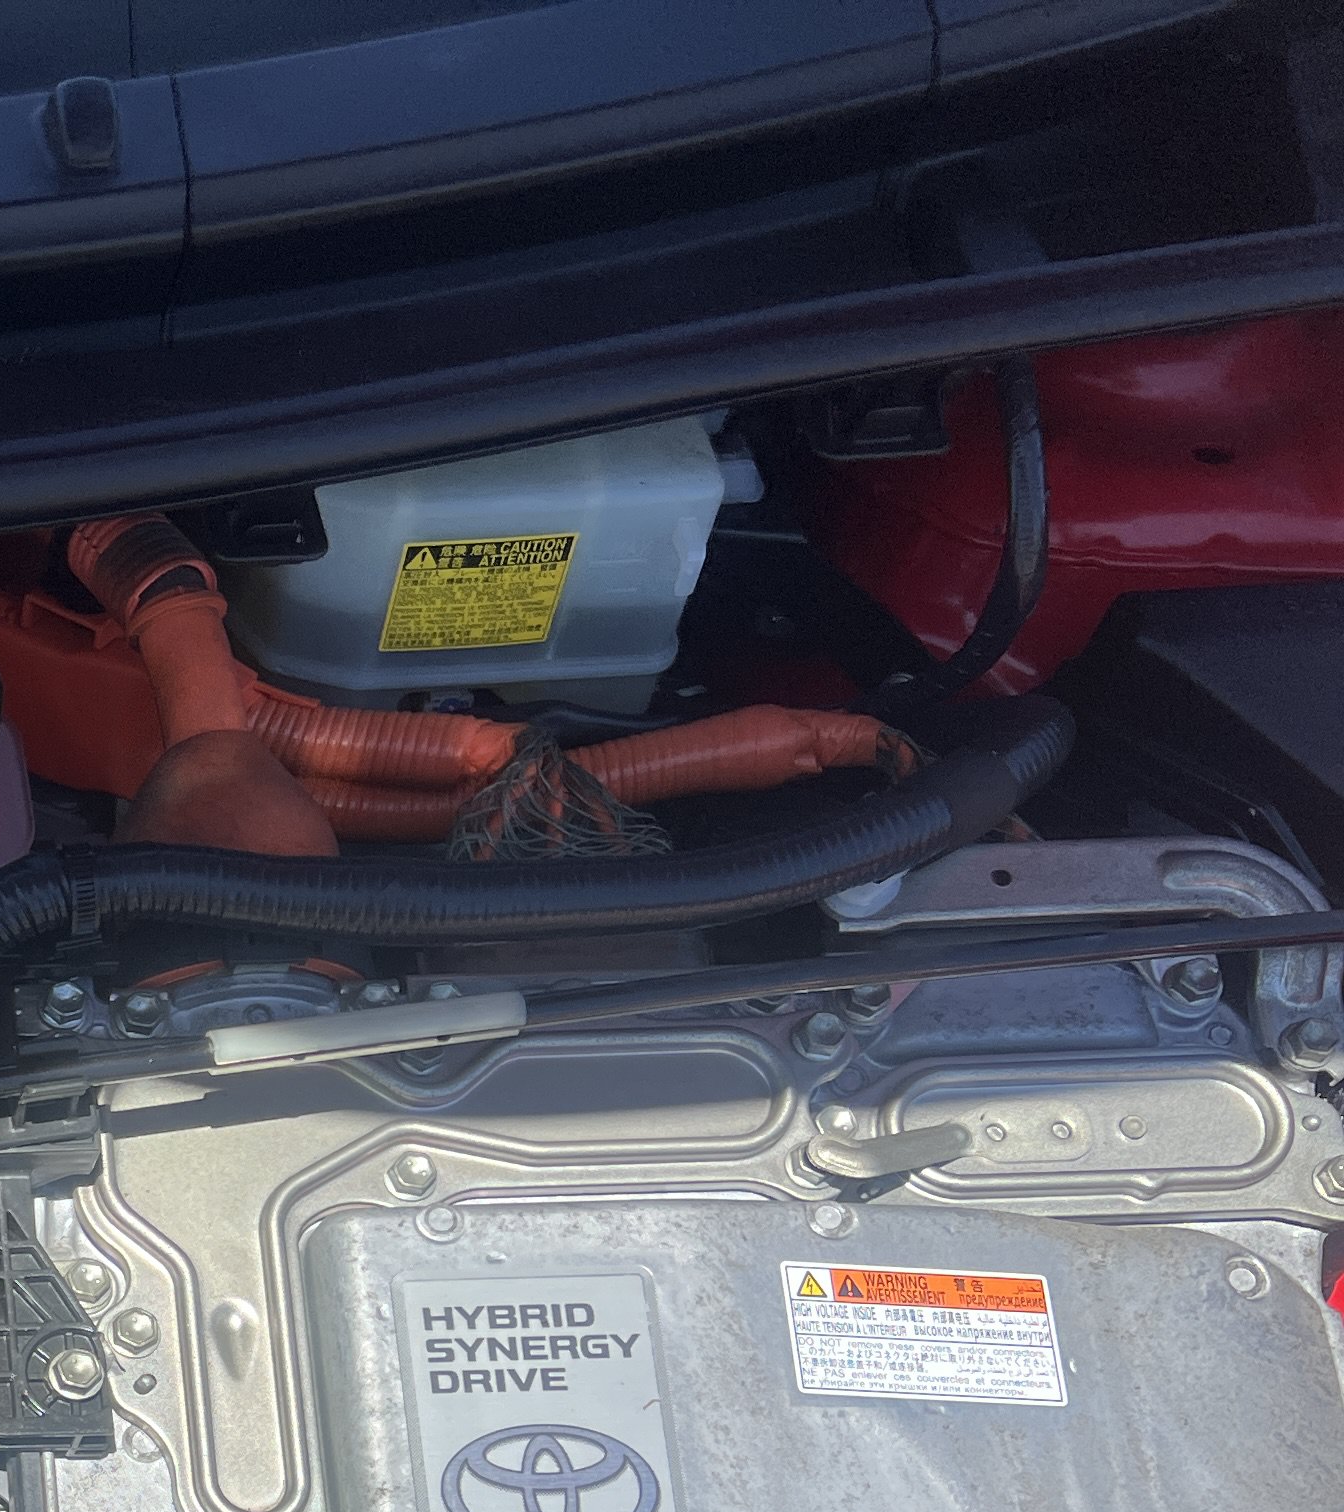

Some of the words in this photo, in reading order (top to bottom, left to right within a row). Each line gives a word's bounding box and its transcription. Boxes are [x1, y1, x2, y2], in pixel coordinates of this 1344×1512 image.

[499, 538, 568, 553] CAUTION
[478, 550, 564, 566] ATTENTION
[863, 1272, 928, 1289] WARNING
[865, 1287, 946, 1304] AVERTISSEMENT
[958, 1293, 1044, 1310] предупреждение
[423, 1303, 595, 1330] HYBRID
[792, 1302, 812, 1317] HIGH
[815, 1303, 849, 1318] VOLTAGE
[852, 1305, 876, 1320] INSIDE
[795, 1319, 821, 1332] HAUTE
[822, 1320, 854, 1333] TENSION
[955, 1327, 1014, 1342] напряжение
[1016, 1330, 1050, 1344] внутри
[428, 1333, 640, 1363] SYNERGY
[798, 1337, 814, 1345] DO
[819, 1338, 842, 1347] NOT
[847, 1339, 883, 1349] remove
[888, 1342, 914, 1351] these
[920, 1343, 952, 1353] covers
[957, 1345, 986, 1354] and/or
[430, 1368, 568, 1394] DRIVE
[802, 1367, 817, 1376] NE
[824, 1368, 845, 1377] PAS
[851, 1370, 887, 1380] enlever
[893, 1372, 911, 1381] ces
[916, 1373, 969, 1384] couvercles
[975, 1376, 985, 1385] et
